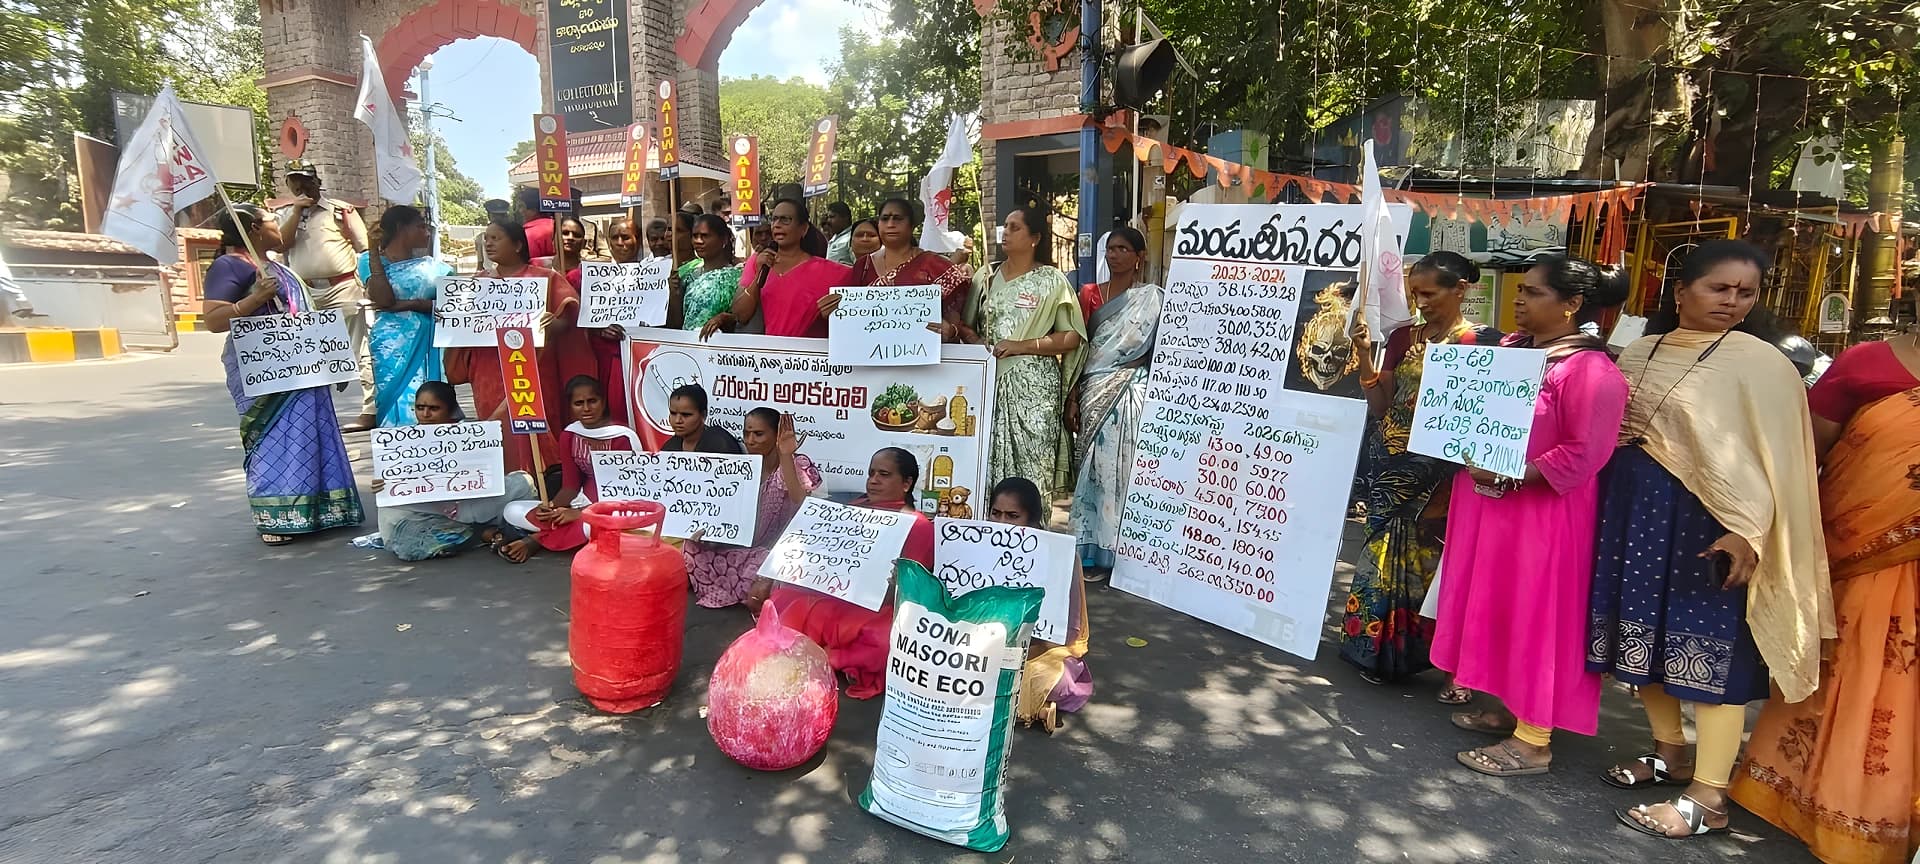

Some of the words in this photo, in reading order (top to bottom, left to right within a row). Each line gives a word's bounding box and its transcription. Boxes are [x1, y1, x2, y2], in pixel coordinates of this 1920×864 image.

[661, 100, 674, 164] AIDWA
[542, 135, 562, 196] AIDWA
[626, 141, 641, 192] AIDWA
[811, 134, 828, 182] AIDWA
[736, 155, 753, 212] AIDWA
[869, 343, 927, 360] AIDWA
[509, 350, 537, 416] AIDWA
[773, 380, 868, 420] అరికట్టాలి
[896, 633, 989, 672] MASOORI
[916, 616, 972, 647] SONA
[891, 656, 929, 688] RICE
[936, 674, 985, 697] ECO
